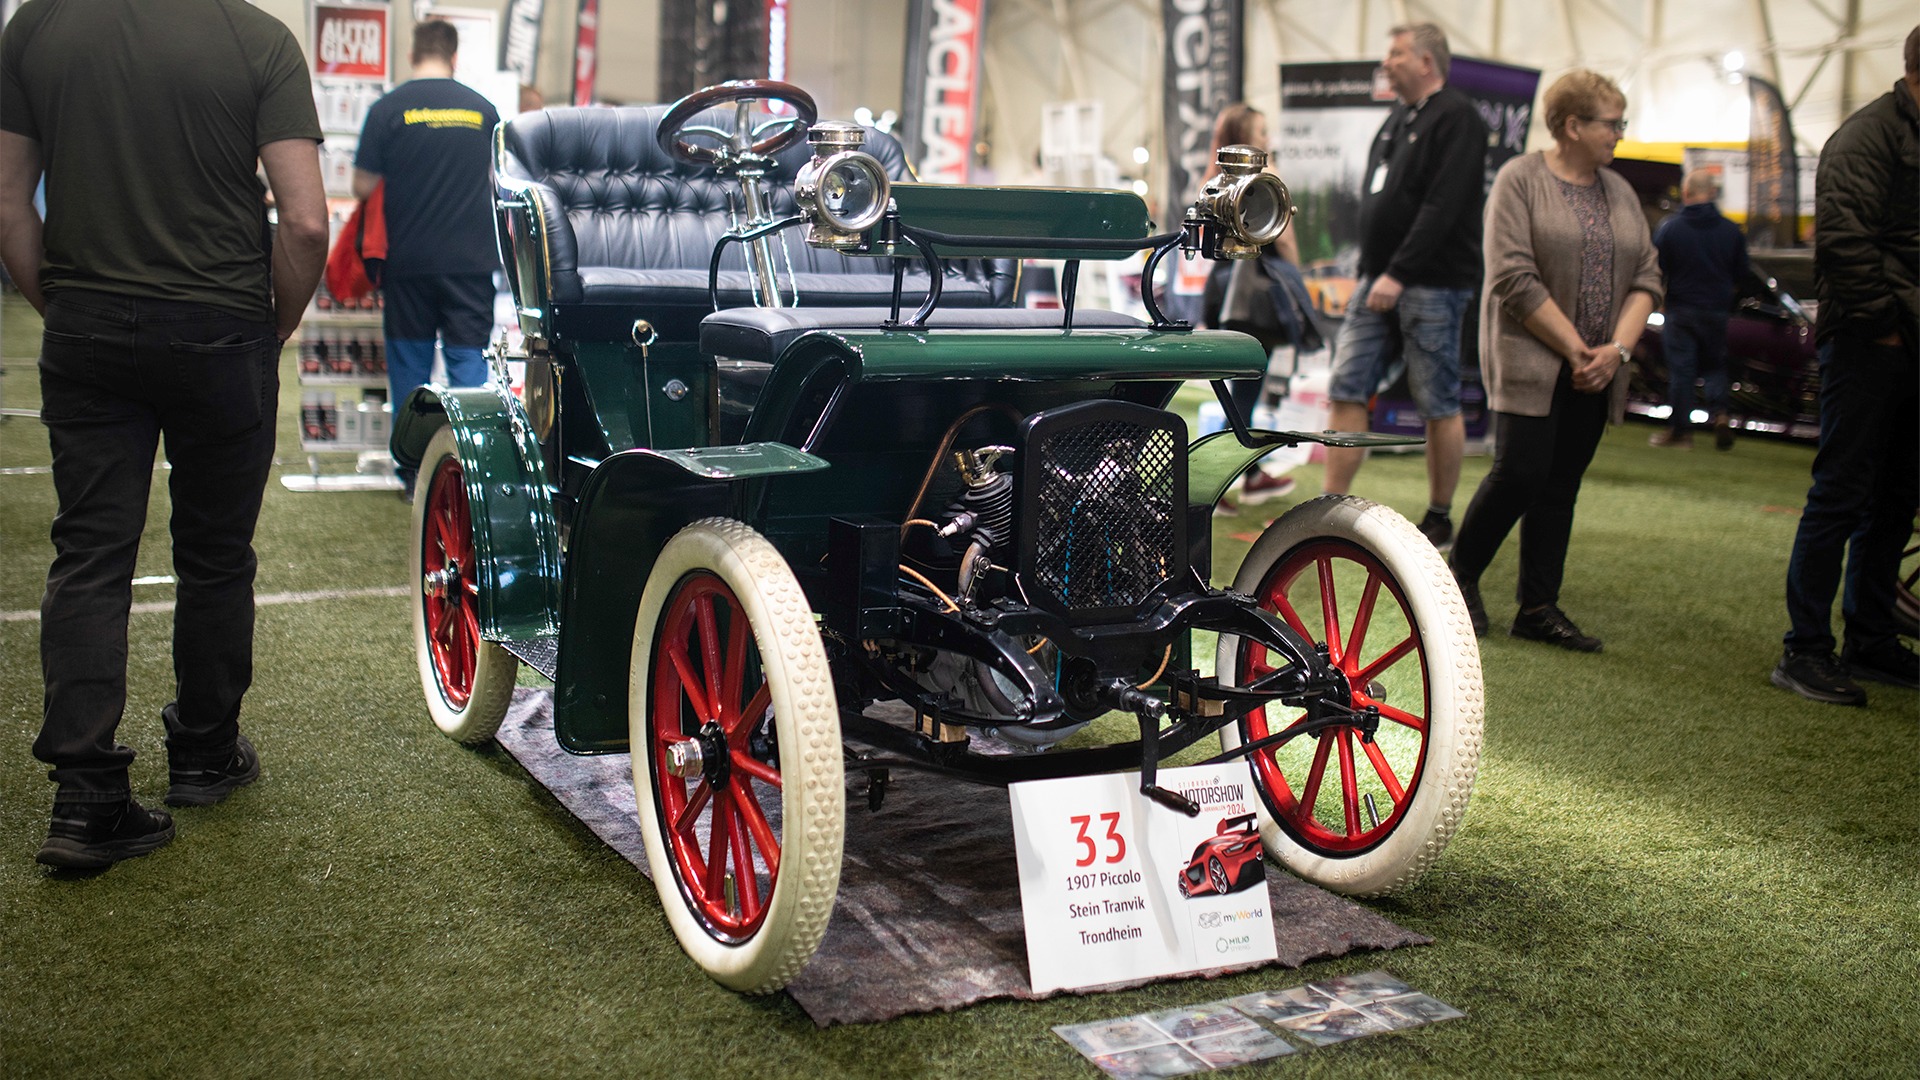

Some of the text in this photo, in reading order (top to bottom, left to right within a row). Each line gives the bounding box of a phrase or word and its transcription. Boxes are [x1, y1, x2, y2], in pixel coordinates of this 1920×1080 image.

[321, 18, 381, 43] AUTO
[320, 41, 381, 67] GLYM
[1227, 803, 1247, 816] 2024
[1070, 811, 1127, 867] 33
[1066, 869, 1142, 891] 1907 Piccolo
[1069, 895, 1146, 919] Stein Tranvik
[1223, 908, 1263, 923] myWorld
[1078, 924, 1143, 945] Trondheim
